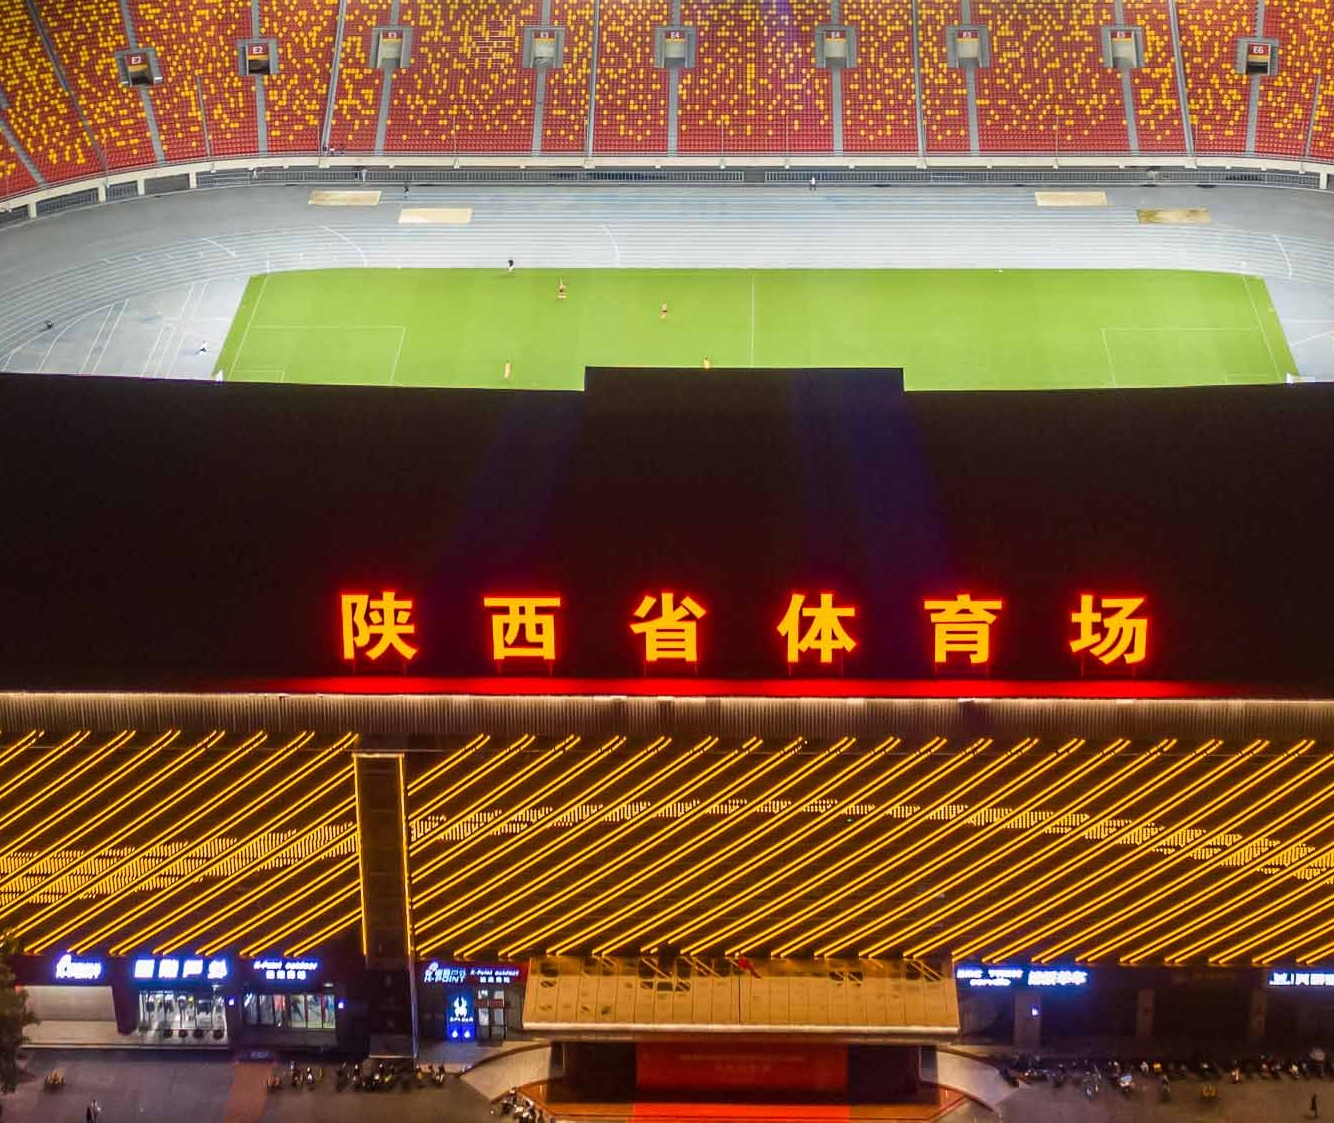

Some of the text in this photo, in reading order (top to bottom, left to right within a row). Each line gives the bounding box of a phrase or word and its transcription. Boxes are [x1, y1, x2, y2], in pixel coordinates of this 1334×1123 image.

[340, 591, 1149, 664] 陕西省体育场
